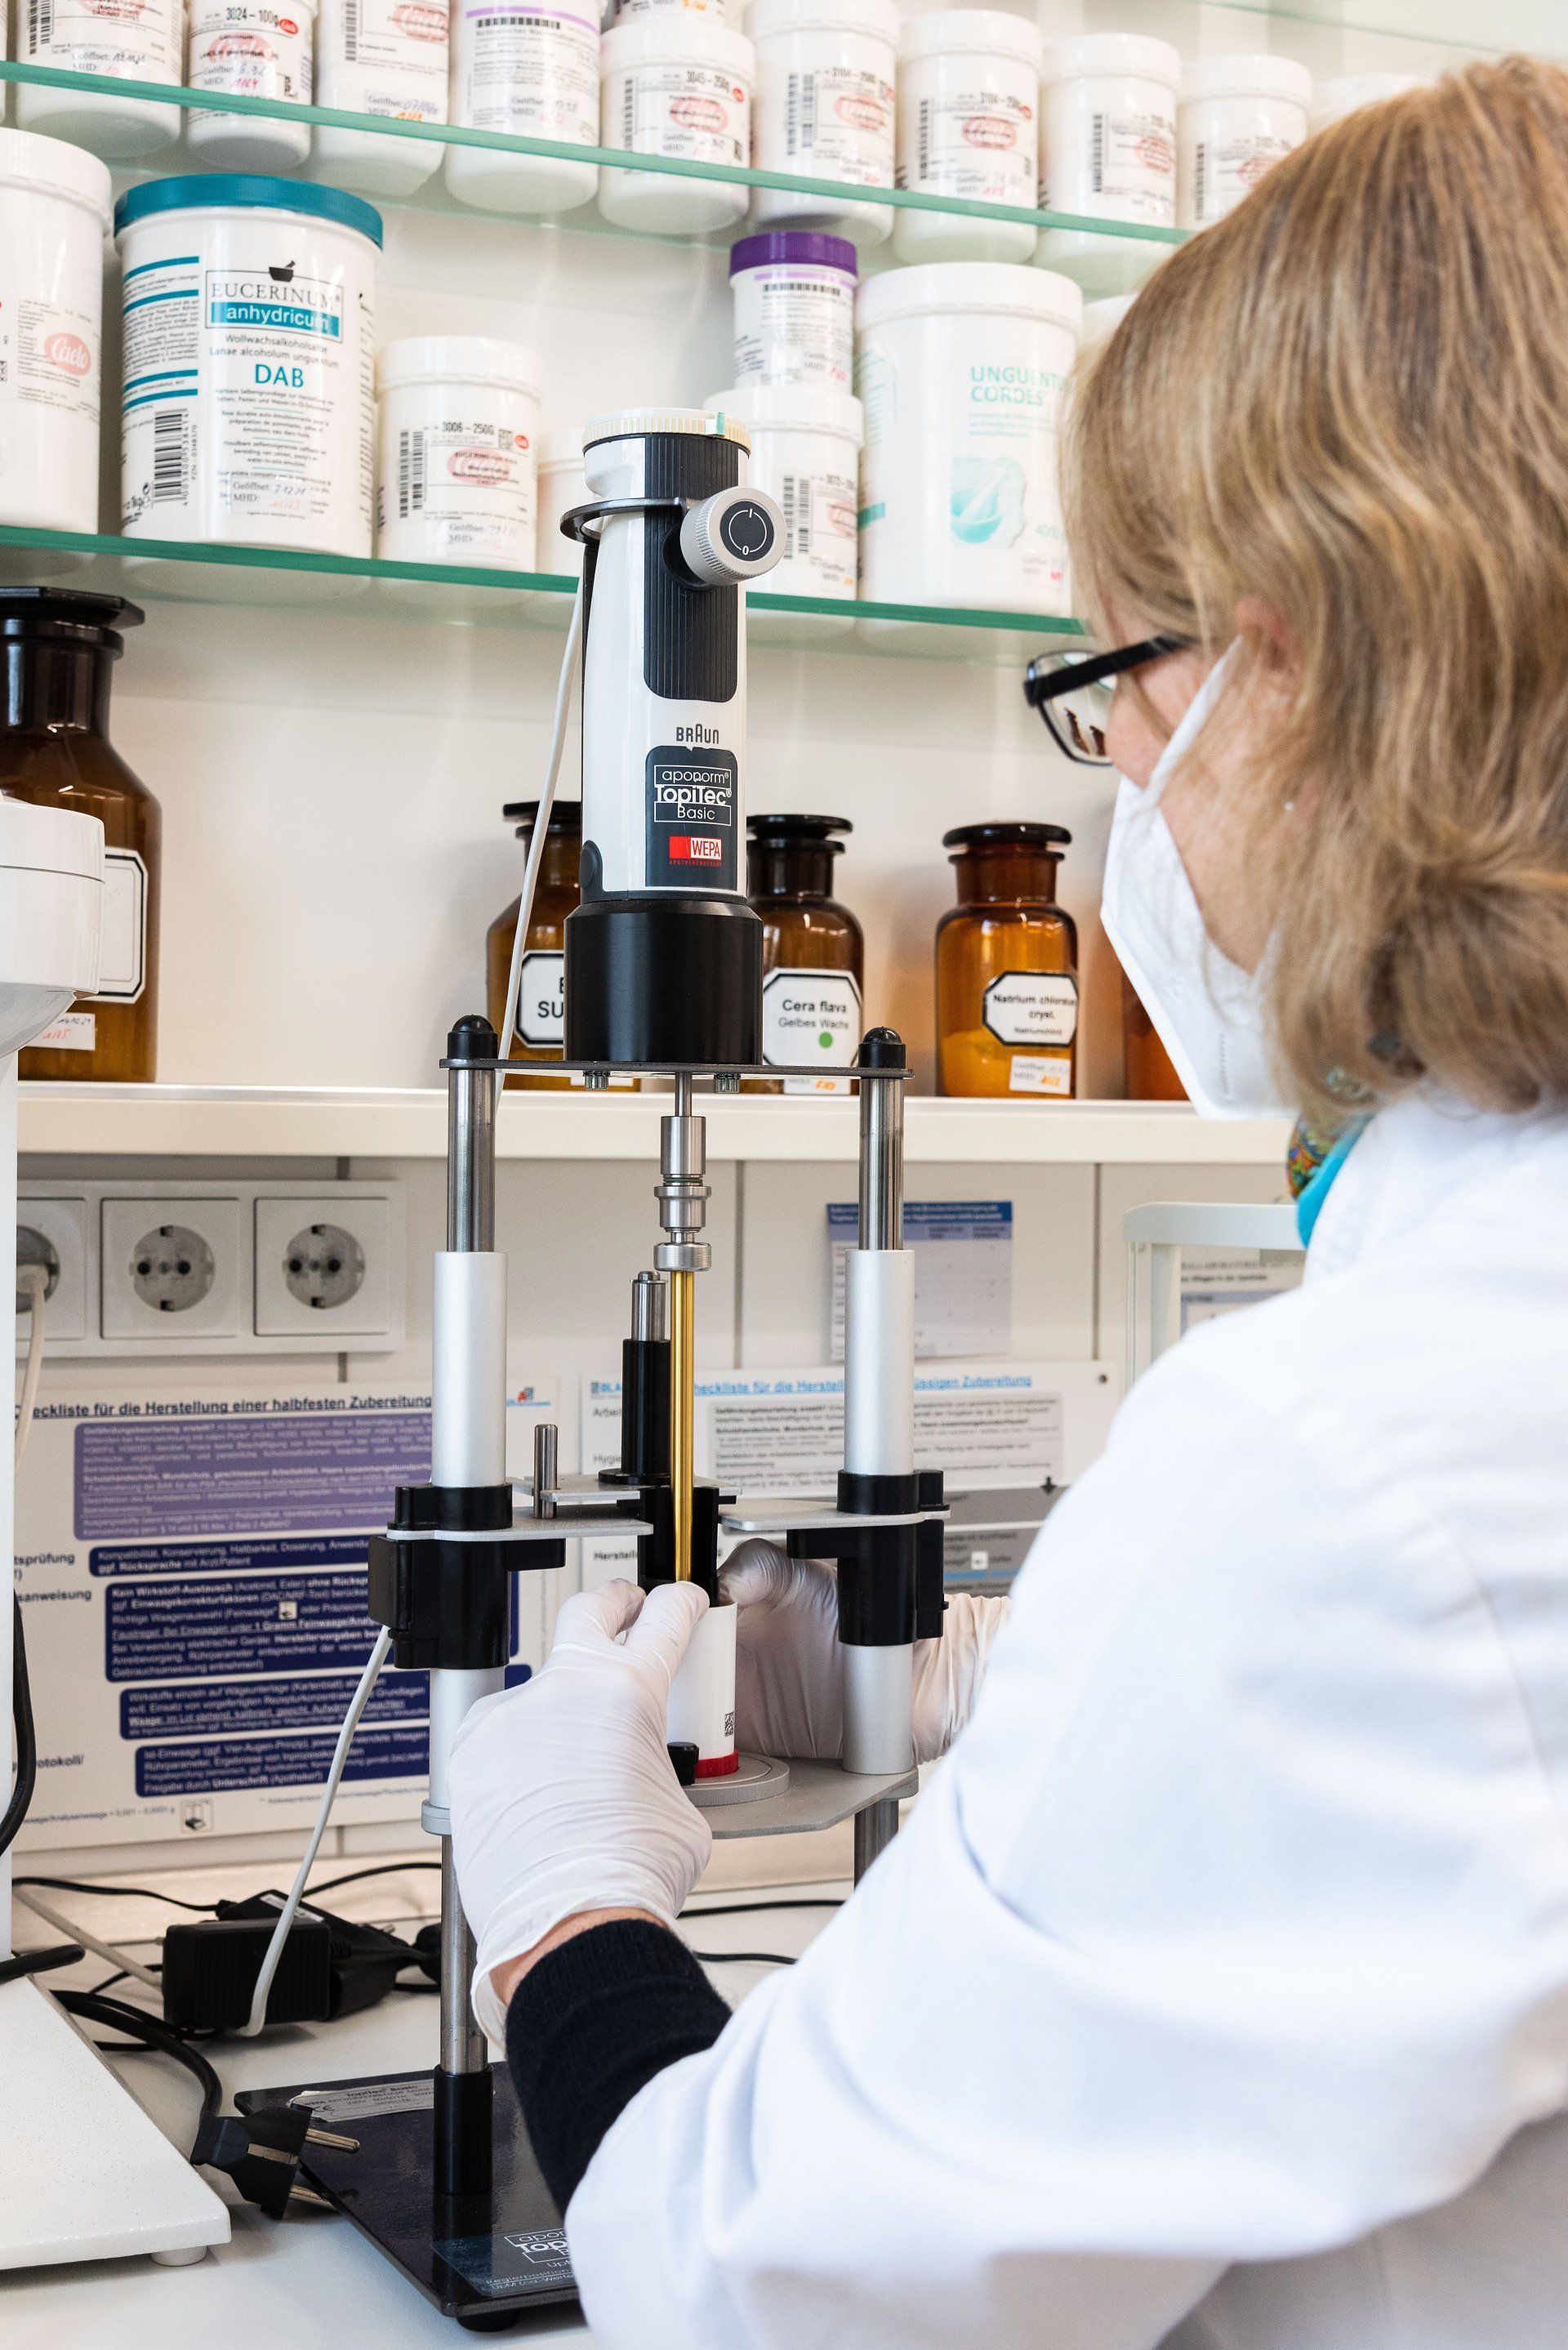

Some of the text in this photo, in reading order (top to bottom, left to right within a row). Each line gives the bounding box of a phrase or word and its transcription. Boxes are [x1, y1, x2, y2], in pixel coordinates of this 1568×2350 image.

[255, 363, 304, 388] DAB
[676, 723, 719, 744] BRAUN
[677, 805, 716, 820] Basic
[692, 839, 721, 858] WEPA
[782, 999, 847, 1013] Cera flava
[778, 1017, 817, 1028] Gelbes
[94, 1403, 114, 1416] für
[118, 1402, 140, 1416] die
[145, 1400, 228, 1417] Herstellung
[233, 1398, 268, 1413] einer
[272, 1395, 345, 1411] halbfesten
[350, 1394, 432, 1410] Zubereitung
